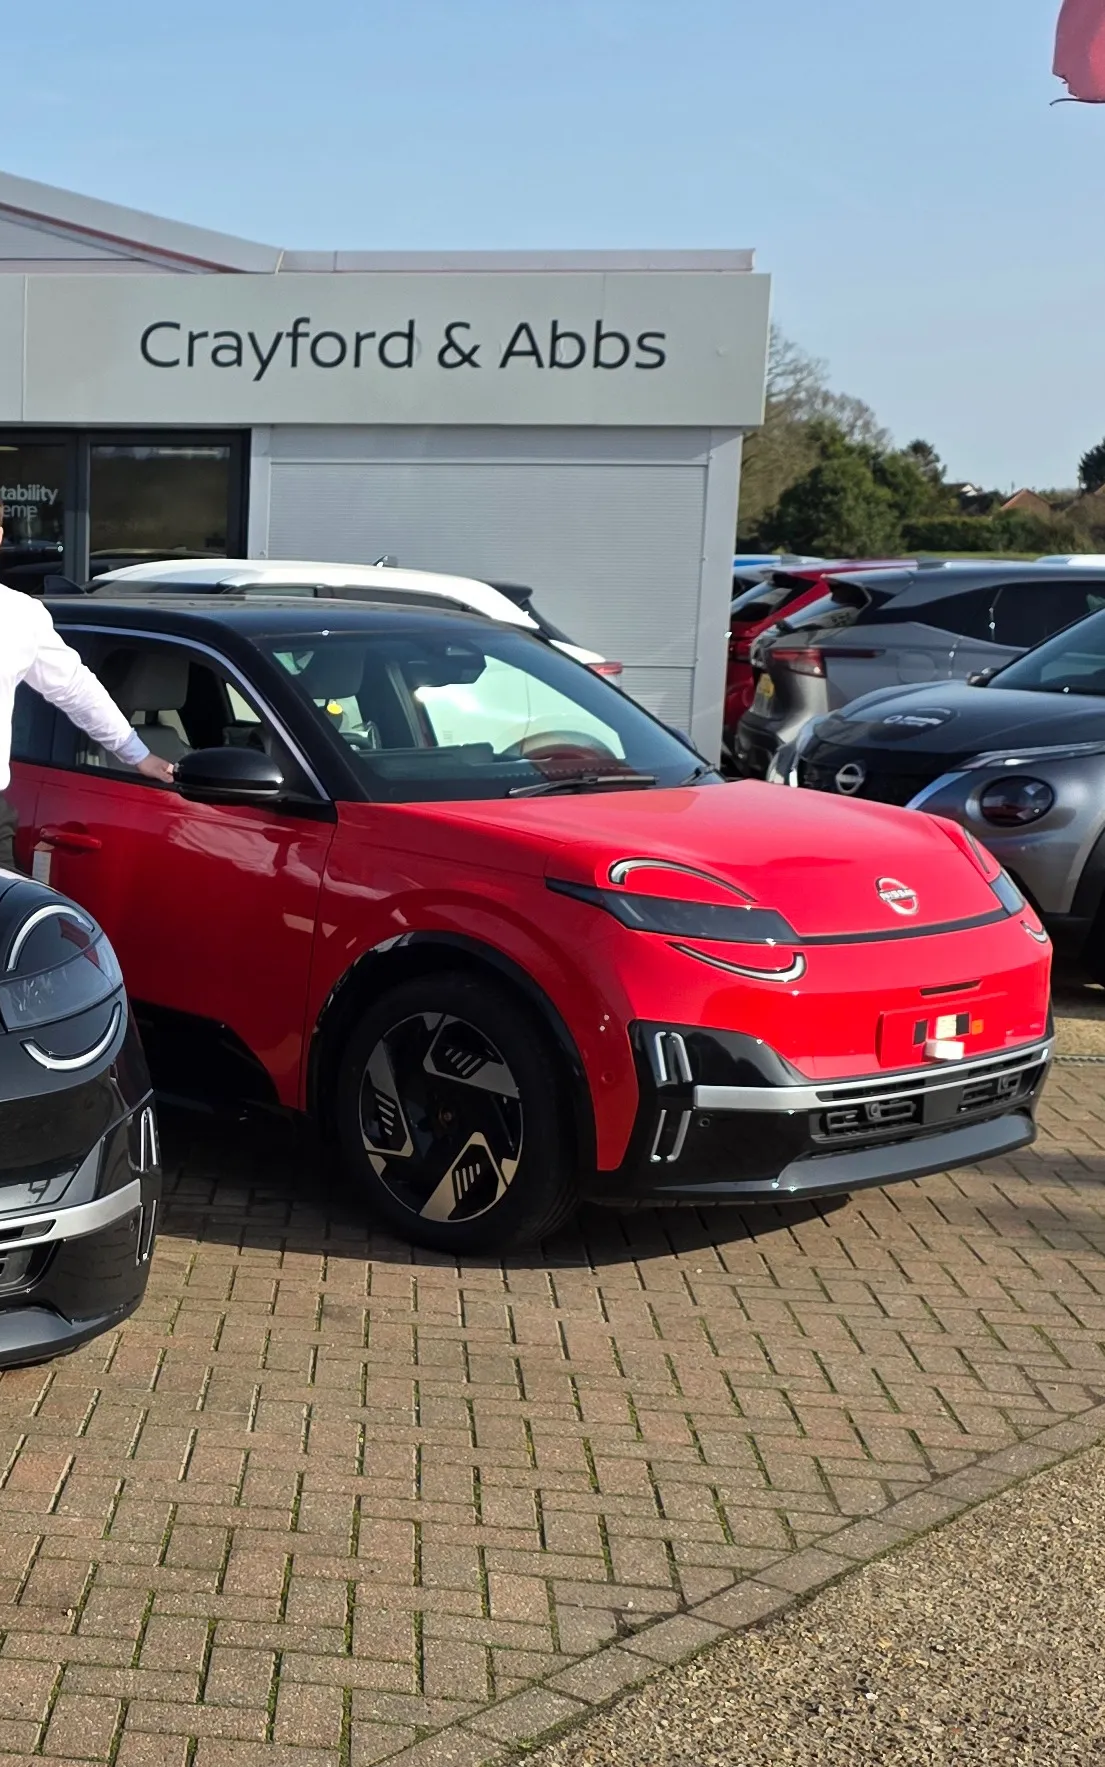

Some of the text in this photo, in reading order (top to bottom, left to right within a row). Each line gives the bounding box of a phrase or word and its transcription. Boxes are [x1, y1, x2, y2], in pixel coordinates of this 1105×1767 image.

[140, 316, 666, 382] Crayford & Abbs
[1, 504, 39, 519] eme
